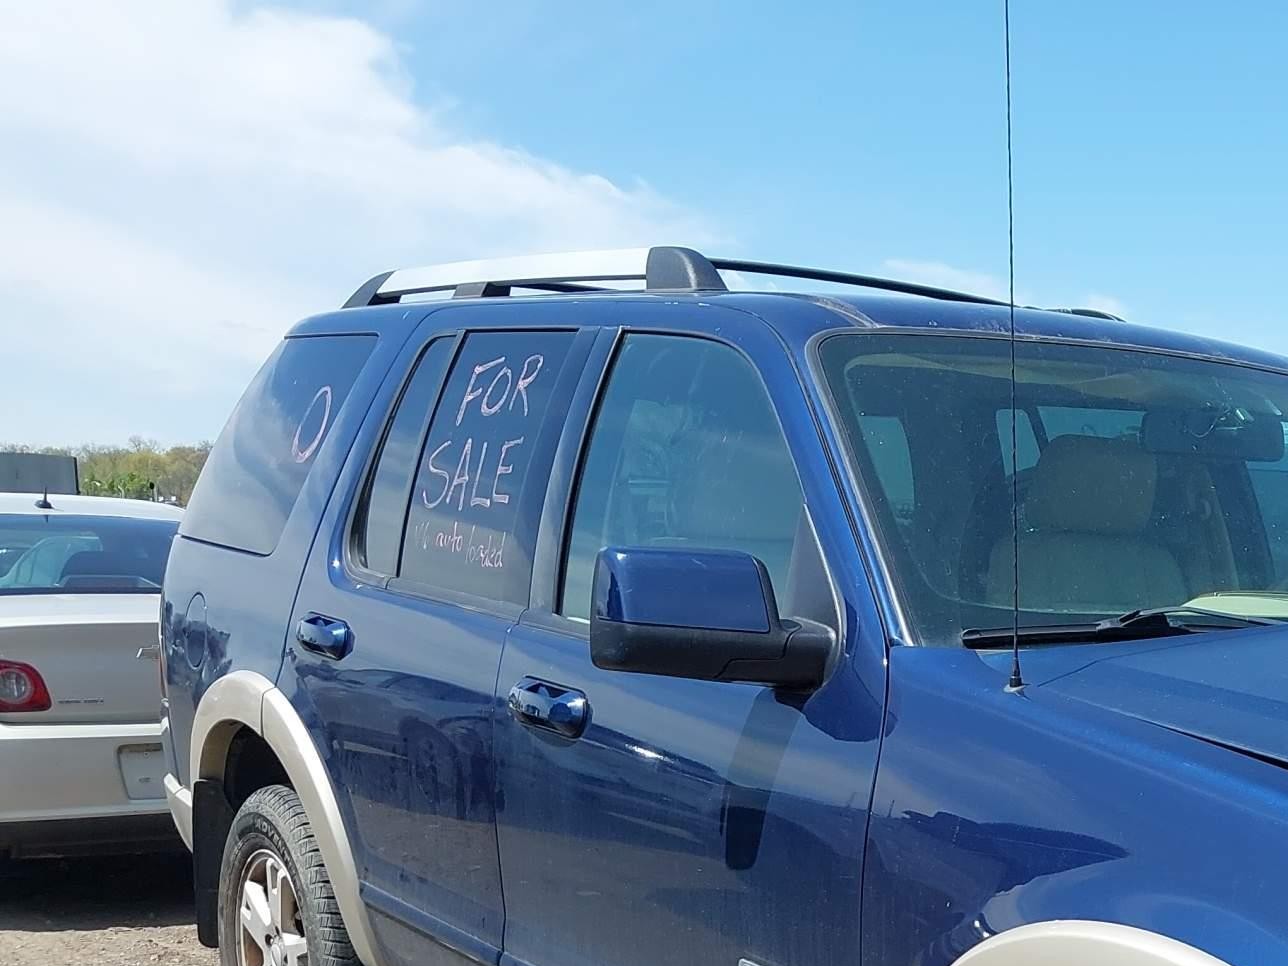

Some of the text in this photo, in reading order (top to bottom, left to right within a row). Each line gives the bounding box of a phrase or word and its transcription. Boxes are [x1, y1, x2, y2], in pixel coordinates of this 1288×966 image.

[455, 354, 544, 427] FOR
[422, 436, 525, 512] SALE
[435, 520, 463, 553] auto
